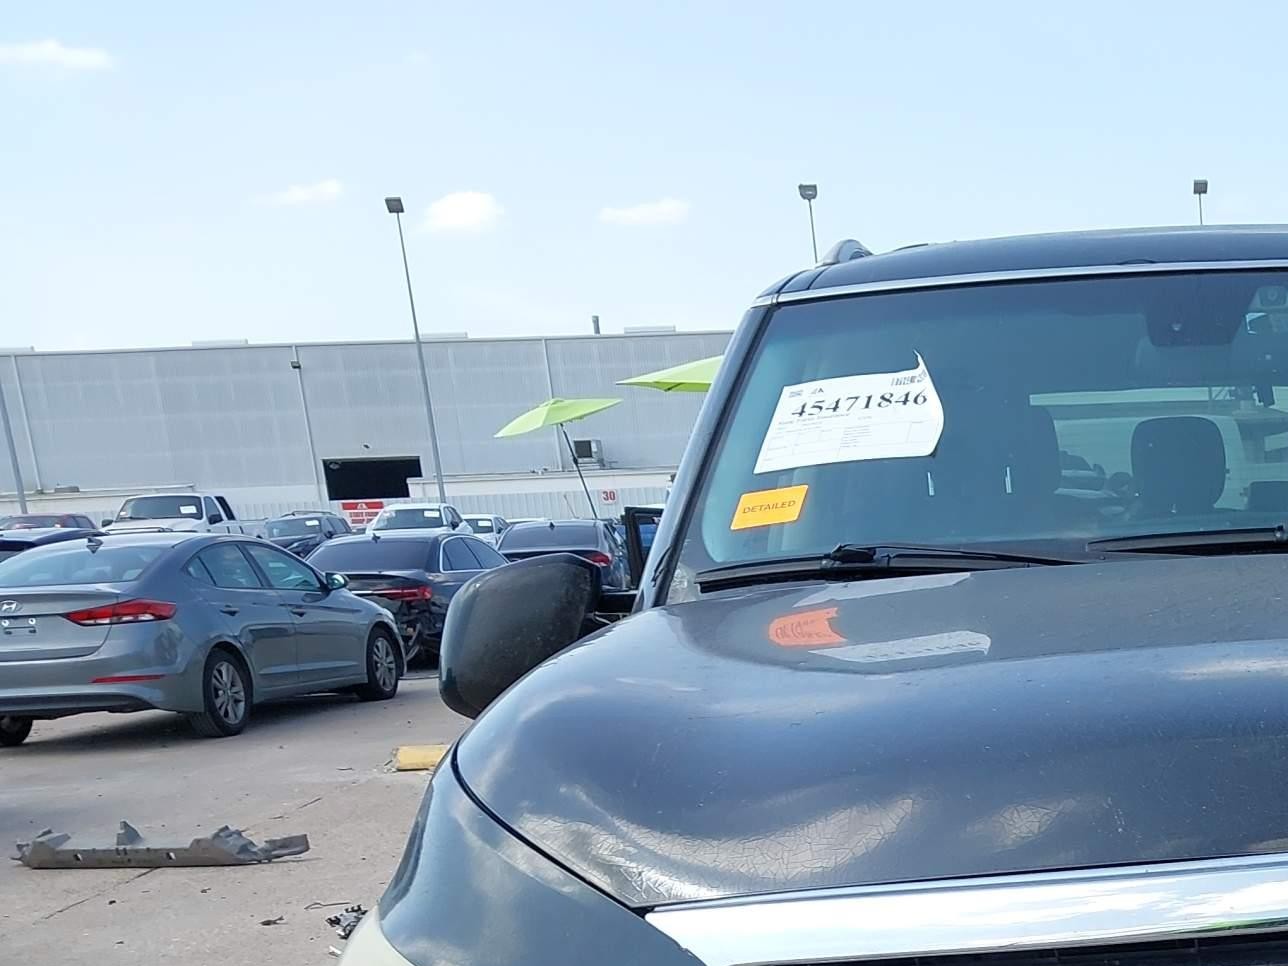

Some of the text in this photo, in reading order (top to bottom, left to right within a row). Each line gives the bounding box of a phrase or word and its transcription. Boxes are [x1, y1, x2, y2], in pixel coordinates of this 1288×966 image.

[791, 387, 928, 418] 45471846
[602, 490, 616, 501] 30
[742, 500, 796, 514] DETAILED
